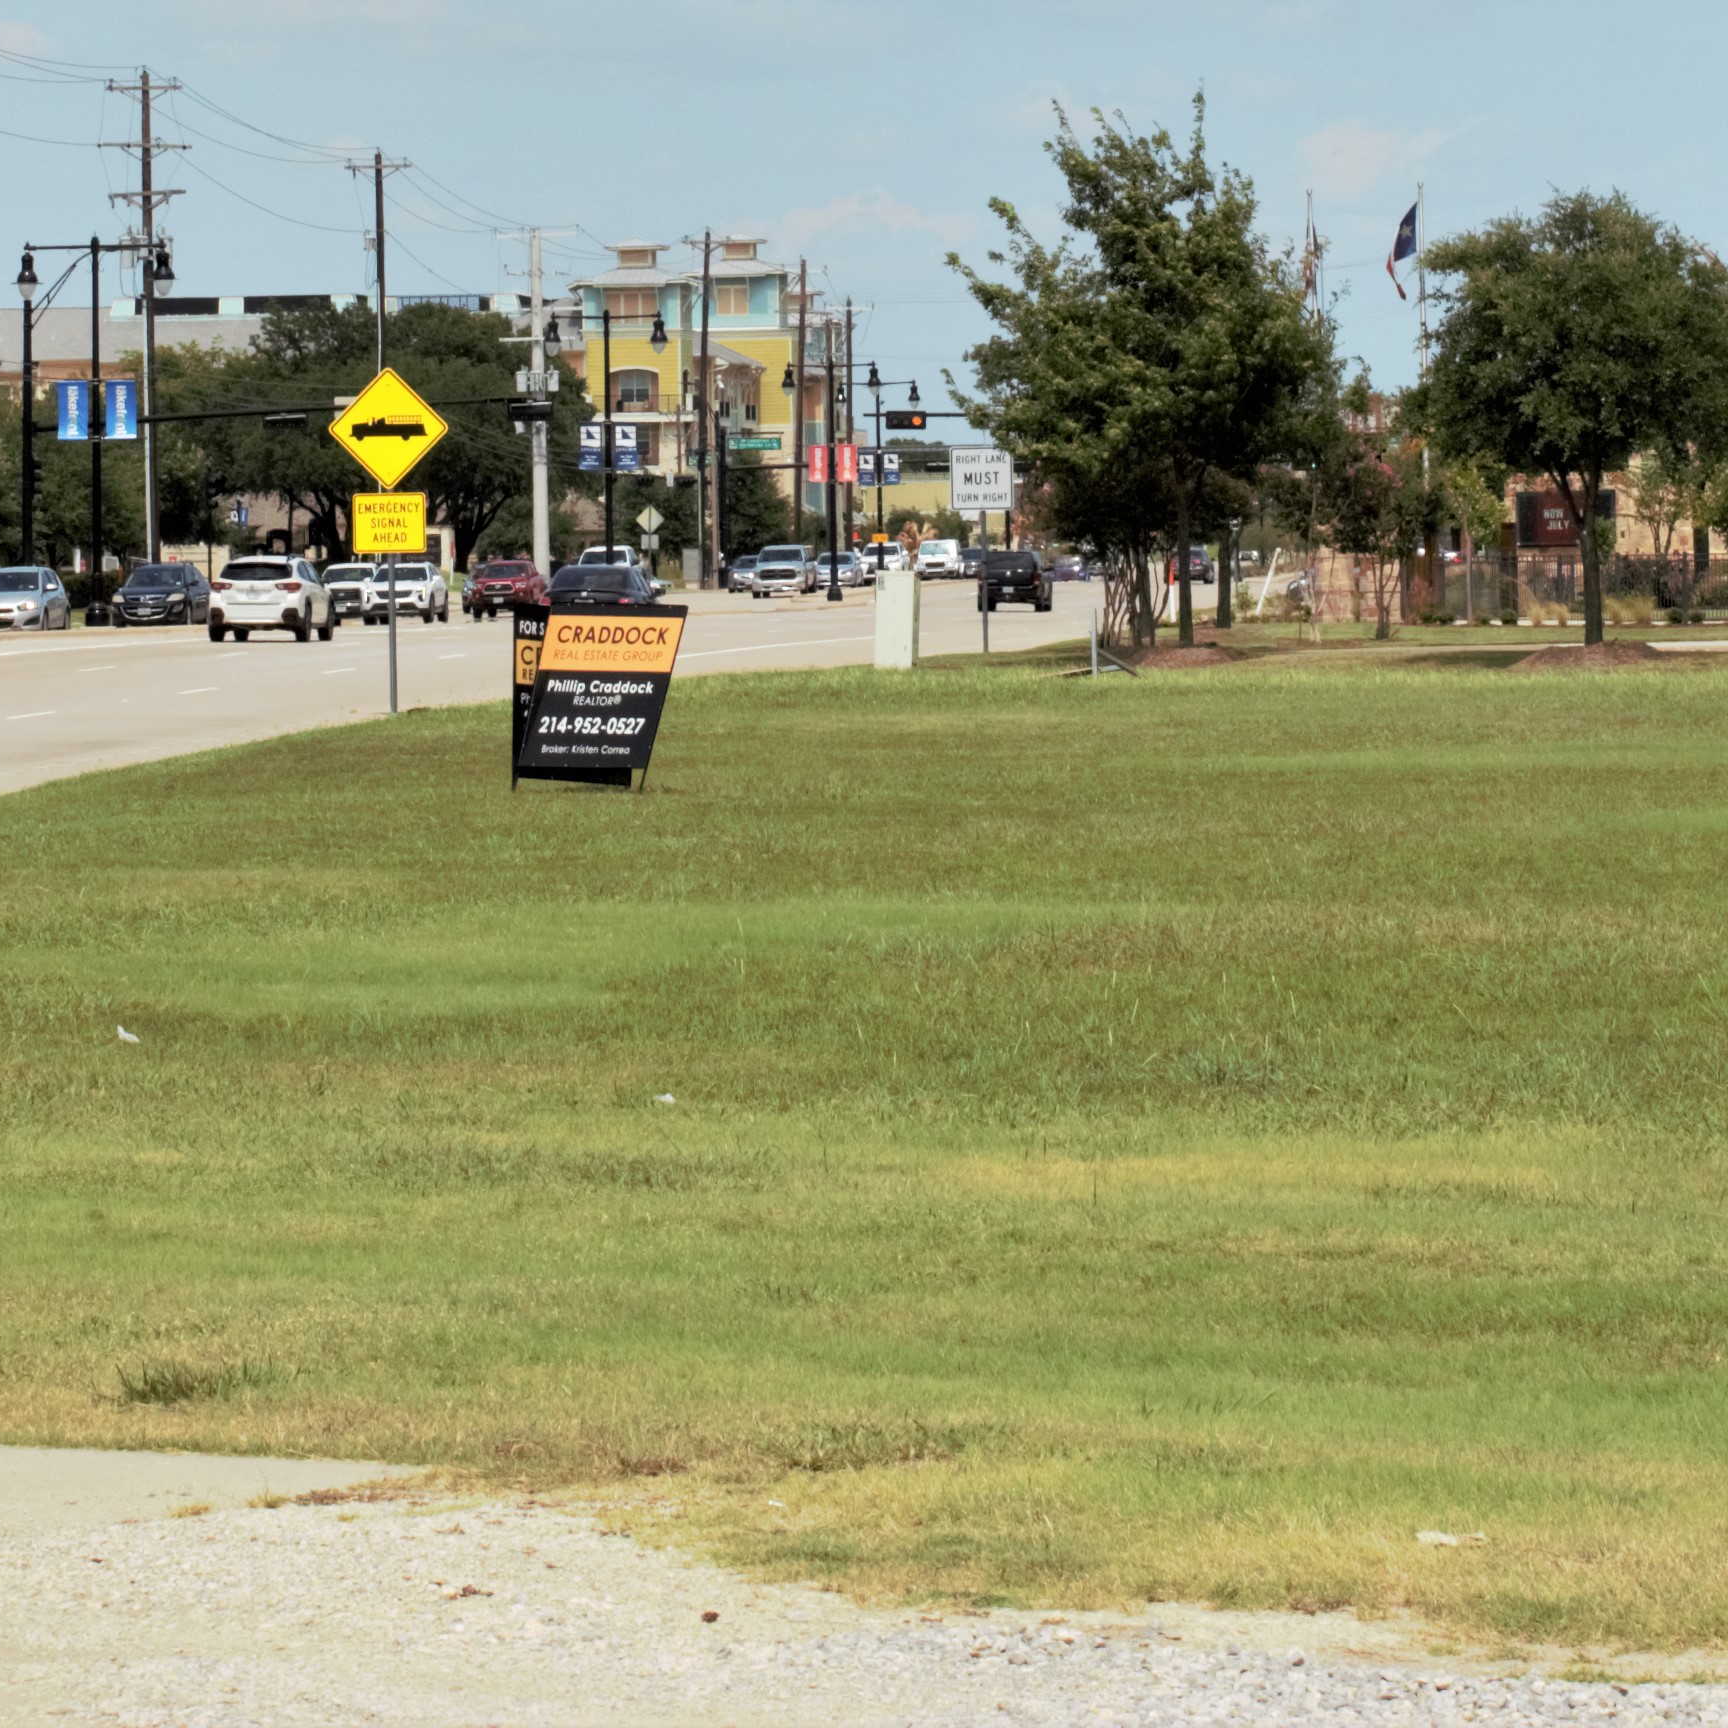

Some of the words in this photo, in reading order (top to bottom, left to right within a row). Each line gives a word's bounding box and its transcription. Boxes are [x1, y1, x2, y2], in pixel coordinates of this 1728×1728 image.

[955, 455, 980, 464] RIGHT
[985, 454, 1007, 464] LANE
[963, 471, 999, 486] MUST
[956, 493, 979, 503] TURN
[982, 492, 1008, 503] RIGHT
[358, 503, 420, 514] EMERGENCY
[1543, 508, 1564, 519] NOW
[371, 518, 408, 528] SIGNAL
[1547, 520, 1570, 530] JULY
[373, 532, 408, 544] AHEAD
[519, 620, 538, 636] FOR
[557, 624, 669, 646] CRADDOCK
[553, 649, 579, 661] REAL
[583, 650, 619, 662] ESTATE
[622, 650, 664, 662] GROUP
[547, 679, 586, 695] Phillip
[589, 680, 654, 694] Craddock
[538, 716, 646, 735] 214-952-0527
[541, 744, 569, 755] Broker:
[571, 744, 599, 755] Kristen
